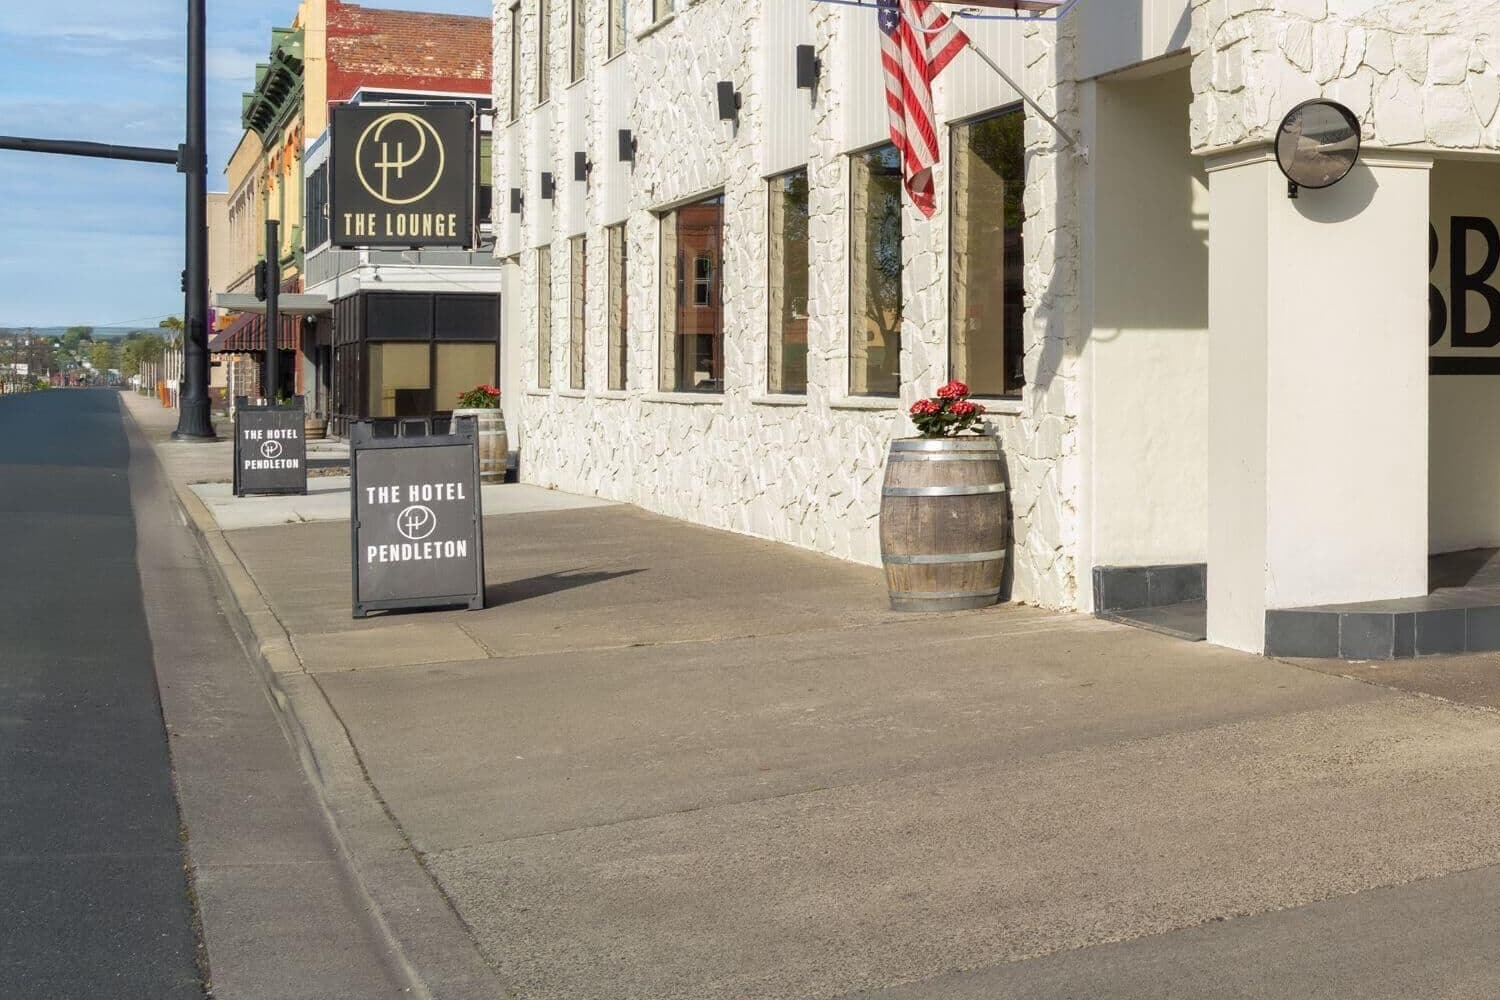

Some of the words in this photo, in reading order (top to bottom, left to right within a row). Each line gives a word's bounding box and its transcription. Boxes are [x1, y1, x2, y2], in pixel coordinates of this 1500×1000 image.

[343, 213, 376, 236] THE
[386, 213, 457, 237] LOUNGE
[244, 430, 263, 440] THE
[267, 429, 298, 439] HOTEL
[244, 458, 299, 470] PENDLETON
[366, 486, 401, 505] THE
[409, 482, 466, 502] HOTEL
[367, 540, 468, 563] PENDLETON
